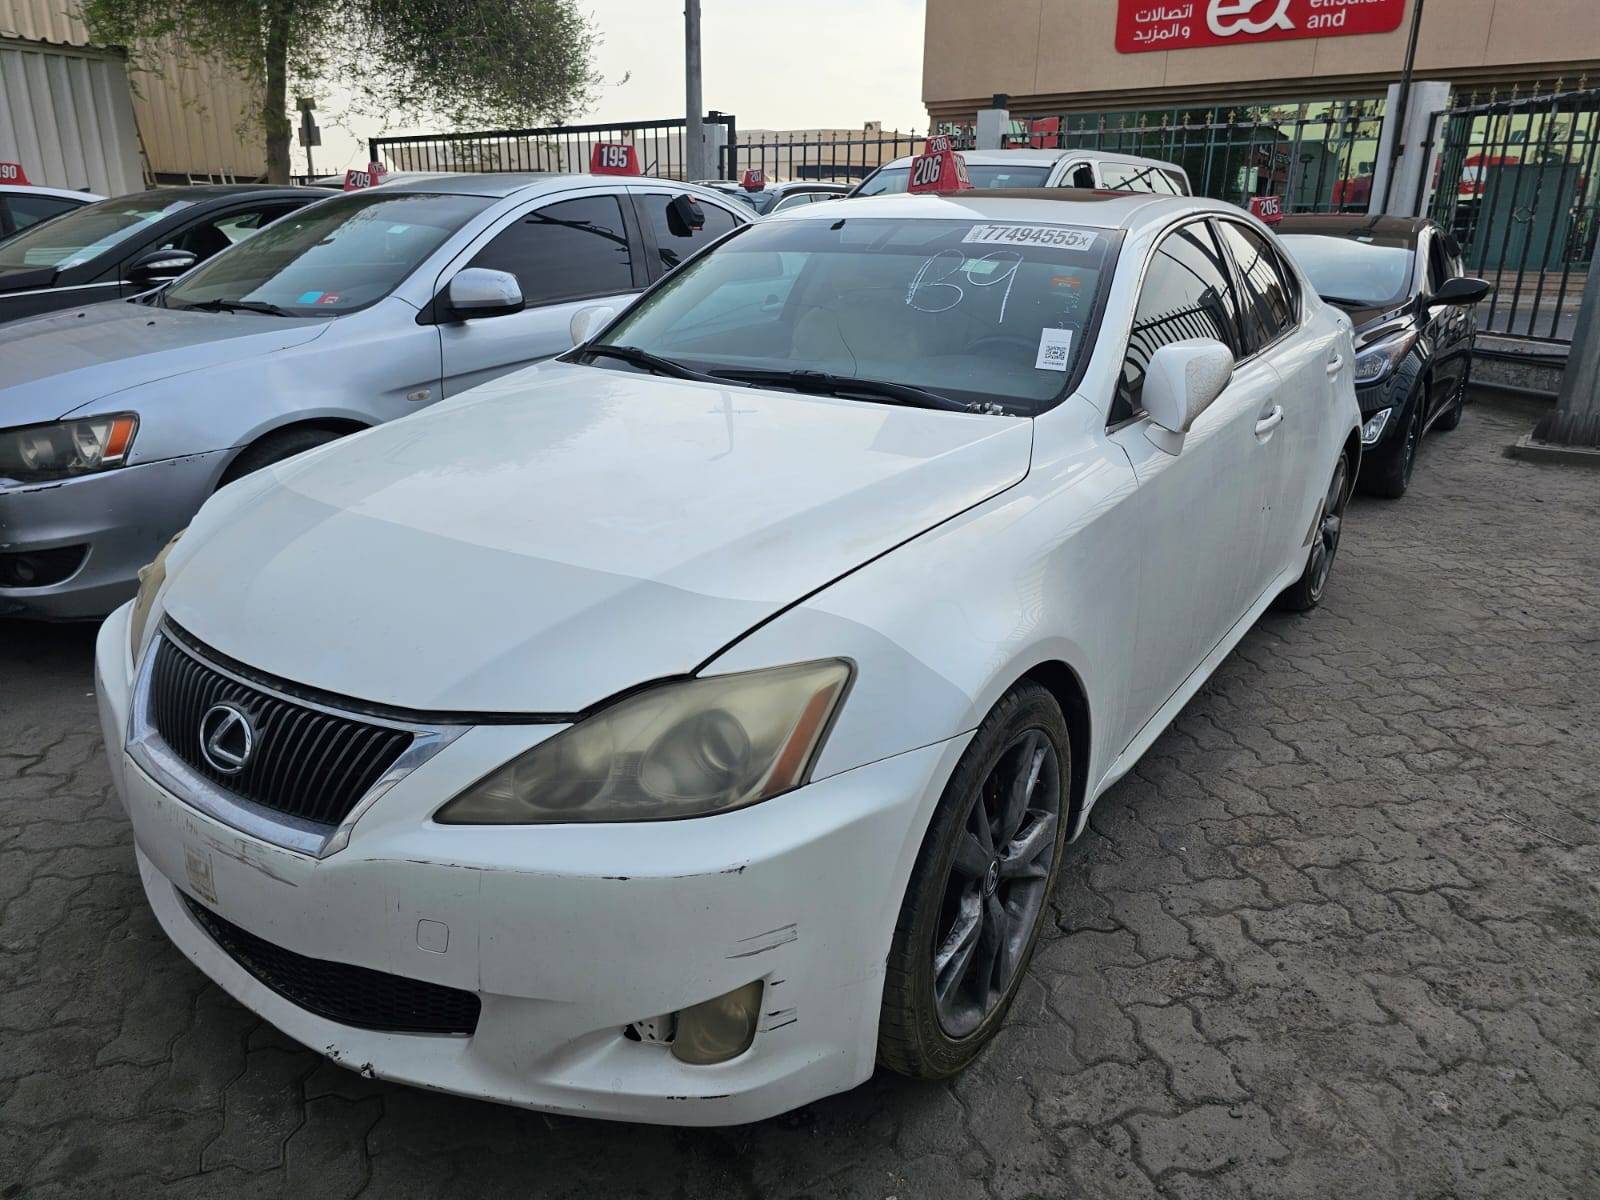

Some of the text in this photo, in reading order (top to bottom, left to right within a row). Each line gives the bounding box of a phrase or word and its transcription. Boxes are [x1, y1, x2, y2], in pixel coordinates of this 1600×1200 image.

[1135, 4, 1193, 23] اتصالات
[1306, 8, 1346, 29] and
[602, 146, 628, 168] 195
[0, 164, 17, 179] 90
[350, 172, 371, 188] 209
[913, 155, 942, 186] 206
[1260, 199, 1279, 217] 205
